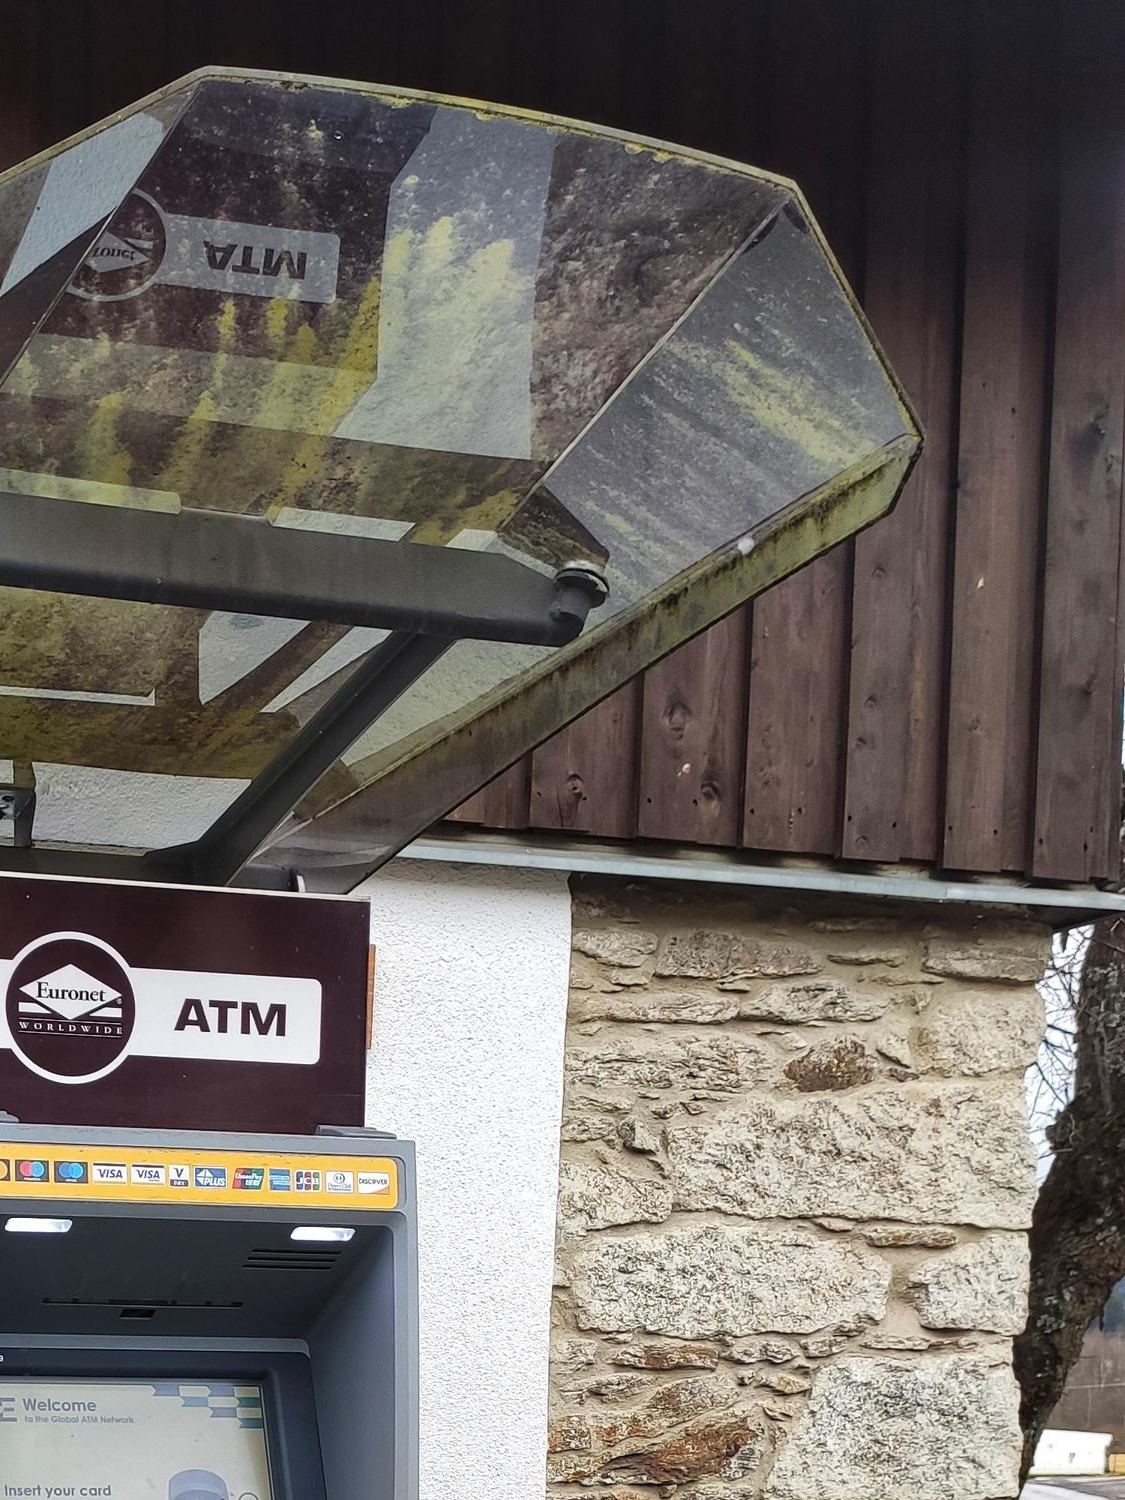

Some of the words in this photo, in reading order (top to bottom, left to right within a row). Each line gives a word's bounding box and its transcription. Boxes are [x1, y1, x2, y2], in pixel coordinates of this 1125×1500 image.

[36, 981, 106, 1002] Euronet
[174, 998, 287, 1037] ATM
[19, 1021, 122, 1034] WORLDWIDE
[98, 1168, 123, 1178] VISA
[136, 1169, 160, 1179] VISA
[204, 1177, 225, 1186] PLUS
[22, 1398, 97, 1411] Welcome
[4, 1484, 41, 1496] Insert
[45, 1486, 76, 1499] your
[80, 1485, 111, 1496] card
